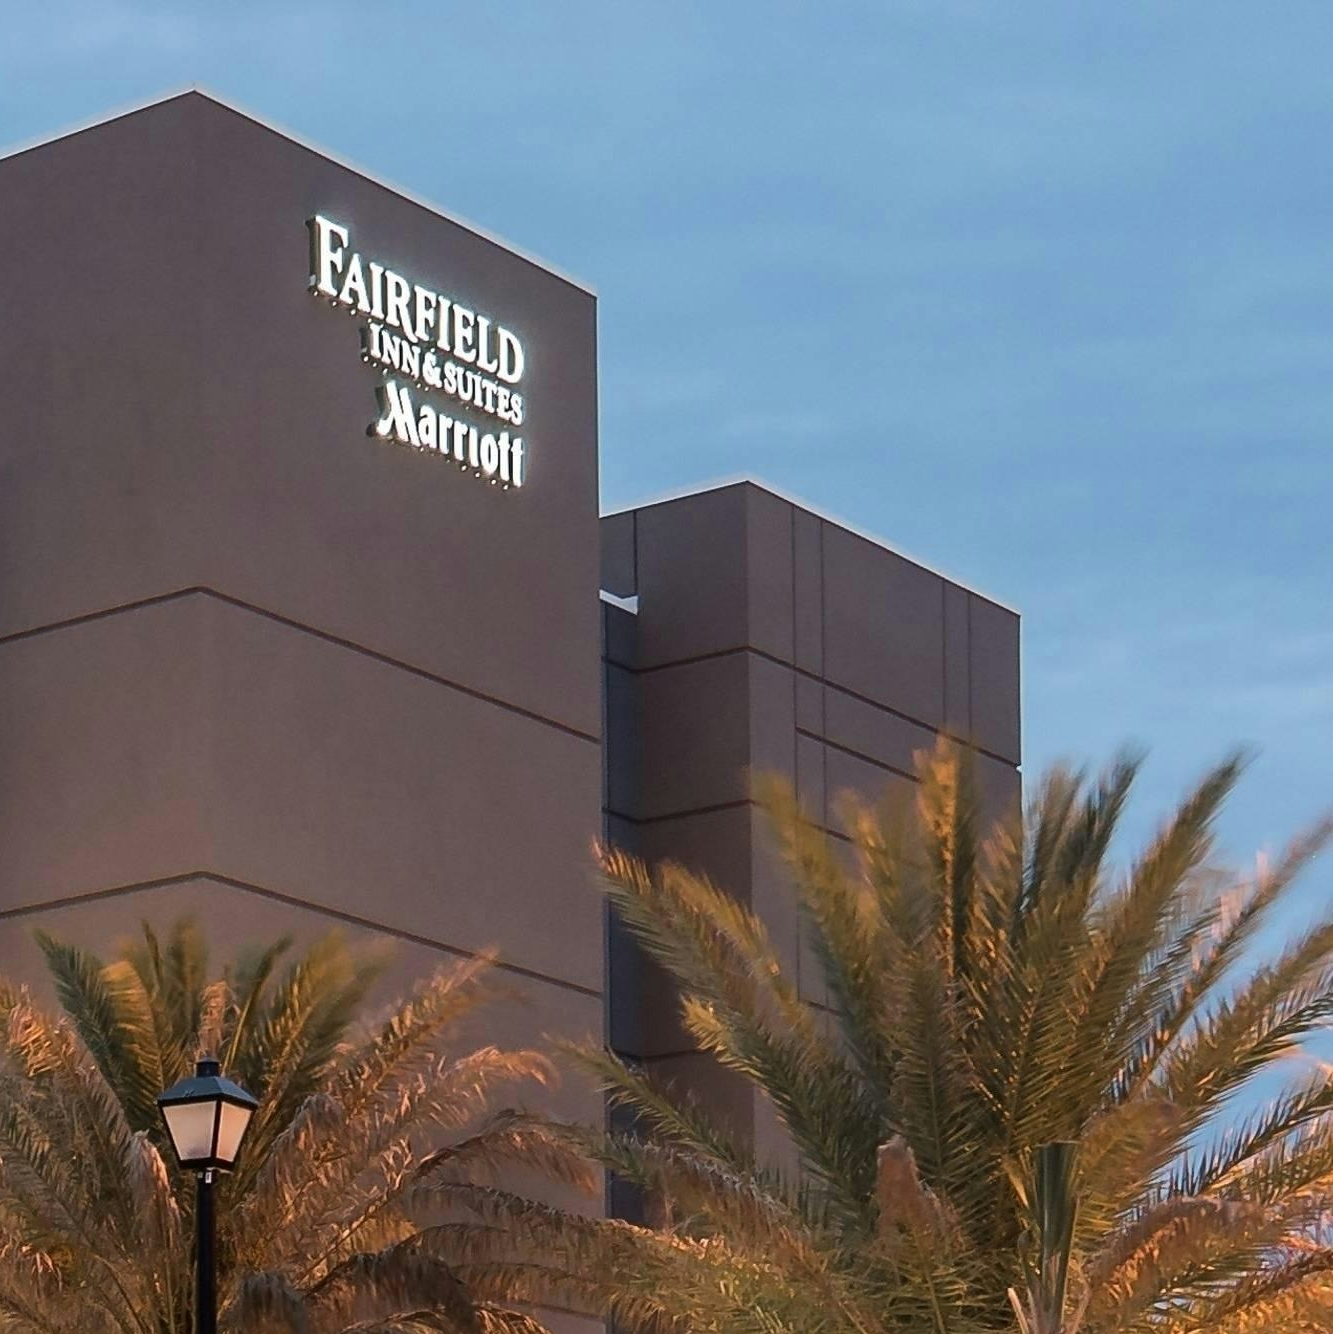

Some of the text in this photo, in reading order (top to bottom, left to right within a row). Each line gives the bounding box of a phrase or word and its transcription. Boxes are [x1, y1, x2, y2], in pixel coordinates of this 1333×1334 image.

[313, 214, 525, 385] FAIRFIELD
[368, 322, 422, 380] INN
[442, 359, 524, 427] SUITES
[375, 379, 526, 488] Marriott
